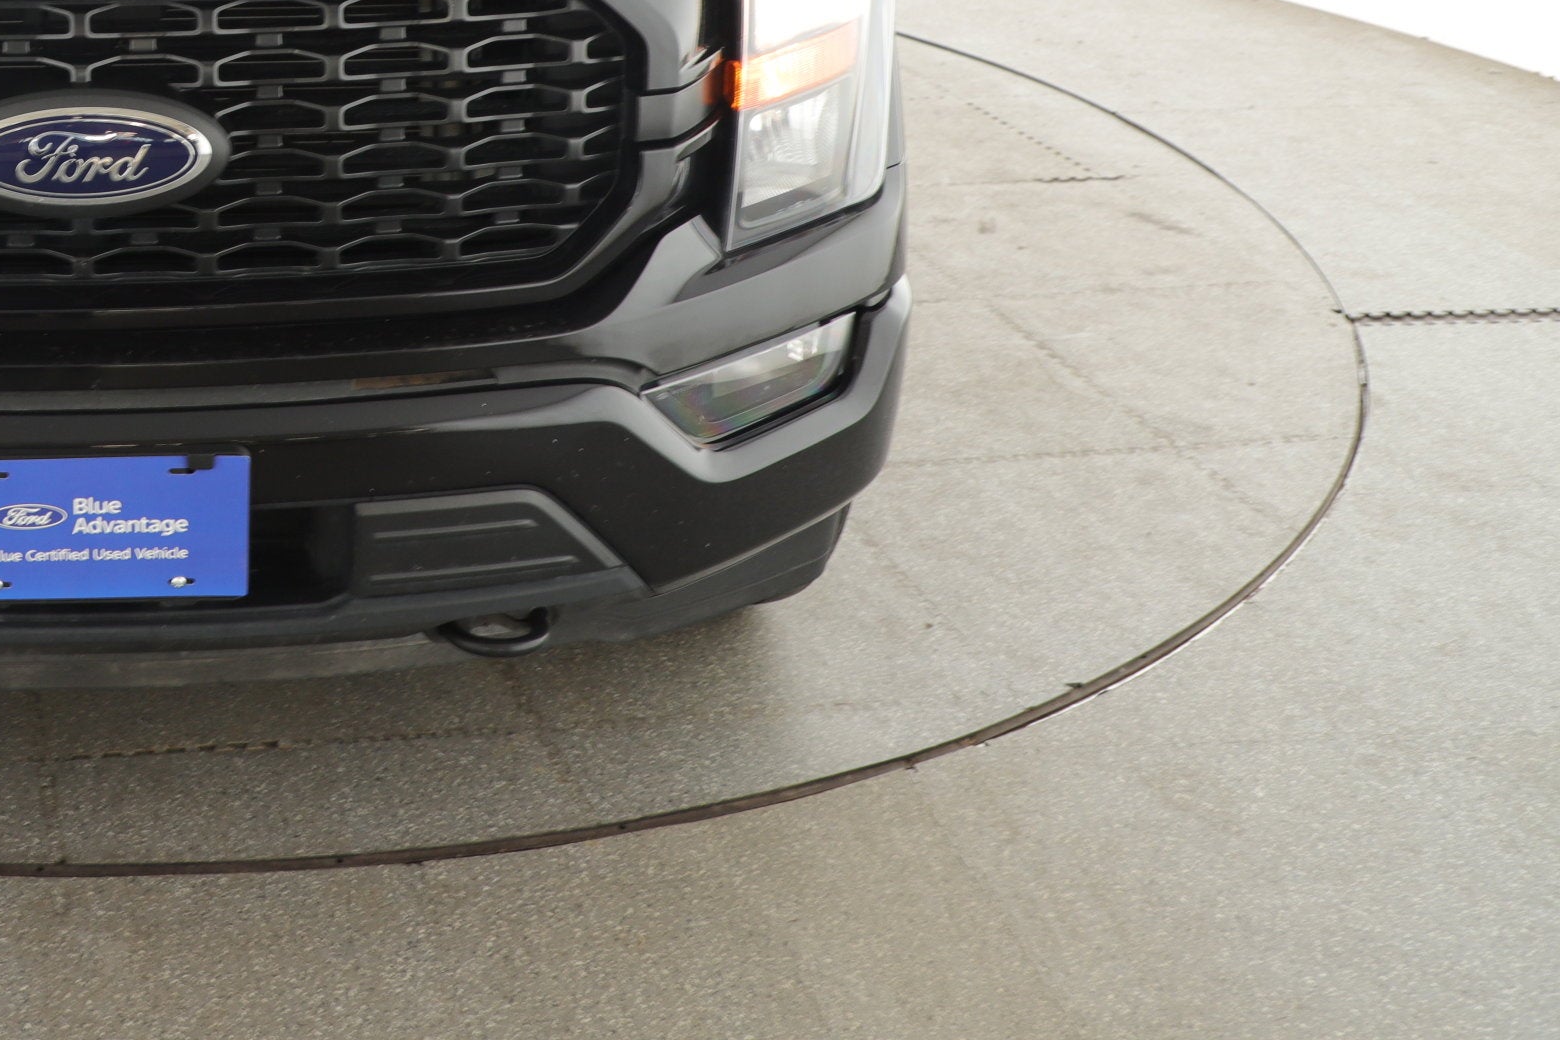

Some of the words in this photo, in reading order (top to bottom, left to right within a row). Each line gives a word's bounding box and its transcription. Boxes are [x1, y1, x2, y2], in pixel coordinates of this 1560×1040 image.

[15, 131, 149, 184] Ford
[73, 498, 122, 515] Blue
[2, 507, 53, 527] Ford
[72, 517, 189, 536] Advantage
[26, 548, 90, 561] Certified
[93, 547, 132, 560] Used
[134, 546, 189, 560] Vehicle
